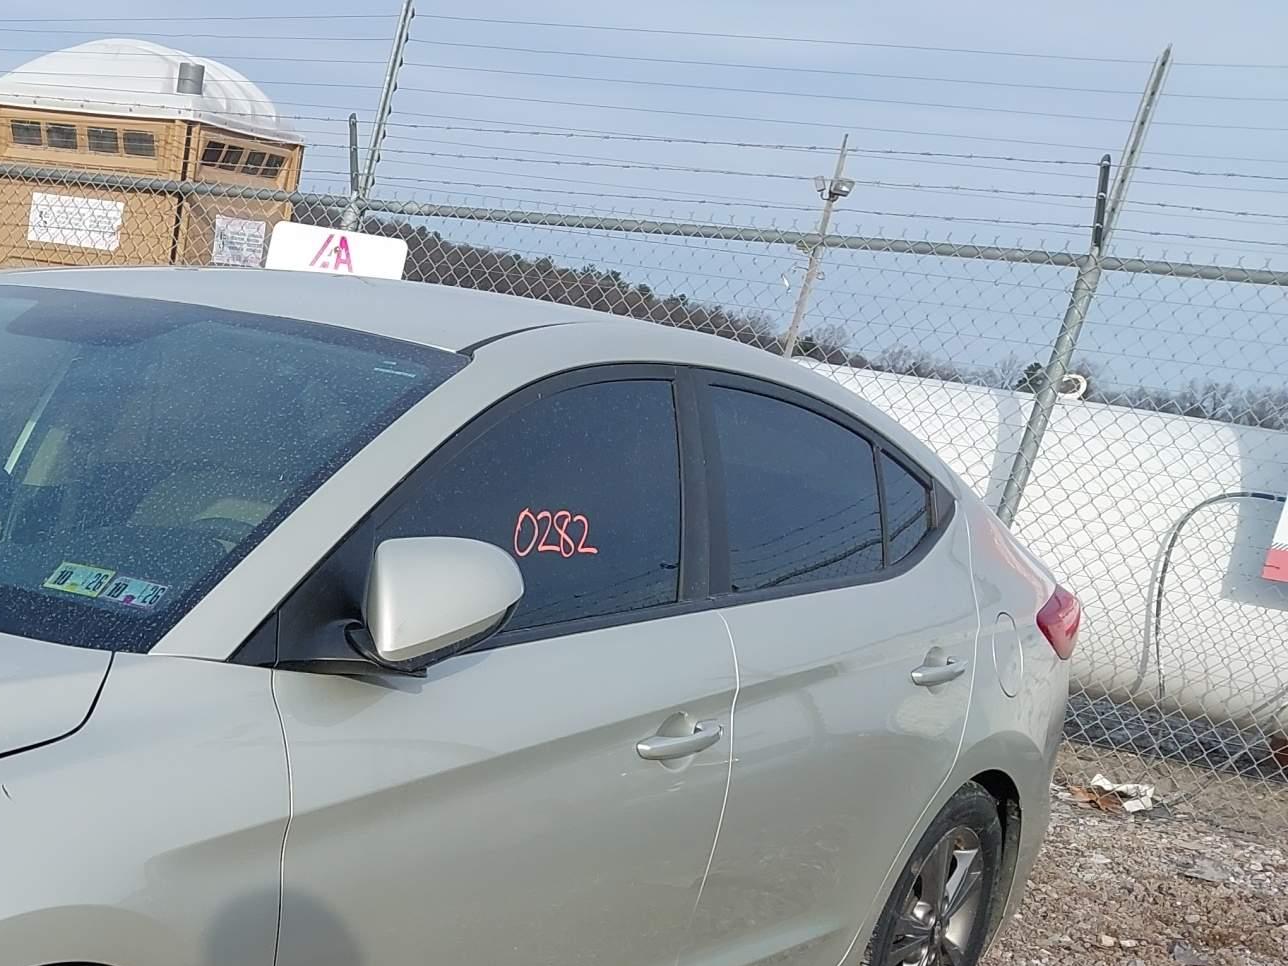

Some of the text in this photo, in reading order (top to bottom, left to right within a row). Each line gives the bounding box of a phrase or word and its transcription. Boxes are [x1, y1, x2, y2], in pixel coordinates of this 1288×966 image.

[514, 507, 598, 558] 0282
[85, 573, 109, 591] 26
[141, 586, 166, 605] 26
